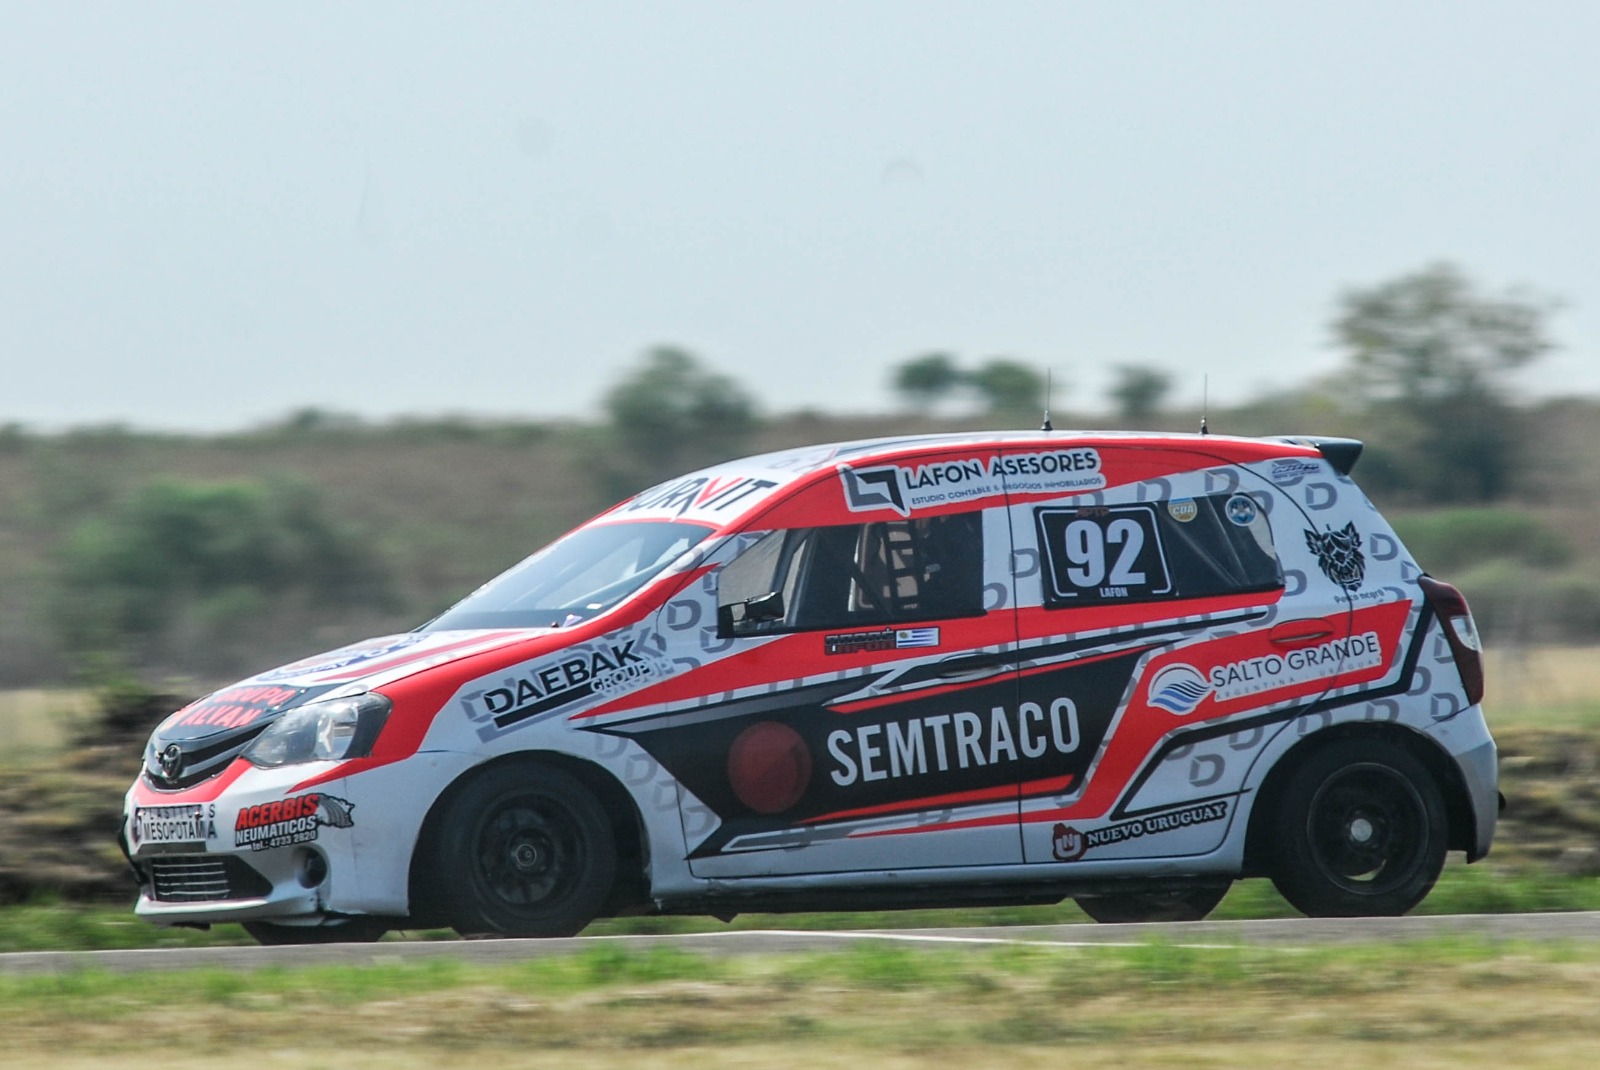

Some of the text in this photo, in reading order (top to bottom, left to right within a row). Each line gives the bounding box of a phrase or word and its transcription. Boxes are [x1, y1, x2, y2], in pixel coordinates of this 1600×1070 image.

[904, 451, 1098, 490] LAFON ASESORES
[911, 493, 945, 504] ESTUDIO
[948, 486, 991, 499] CONTABLE
[1044, 477, 1102, 489] INMOBILIARIOS
[1065, 518, 1146, 588] 92
[1100, 587, 1128, 598] LAFON
[484, 639, 645, 713] DAEBAK
[590, 662, 651, 694] GROUP
[1212, 635, 1378, 688] SALTO GRANDE
[827, 697, 1081, 787] SEMTRACO
[236, 793, 319, 831] ACERBIS
[236, 816, 317, 845] NEUMATICOS
[1087, 803, 1226, 847] NUEVO URUGUAY
[270, 836, 292, 848] 4733
[293, 830, 316, 843] 2820
